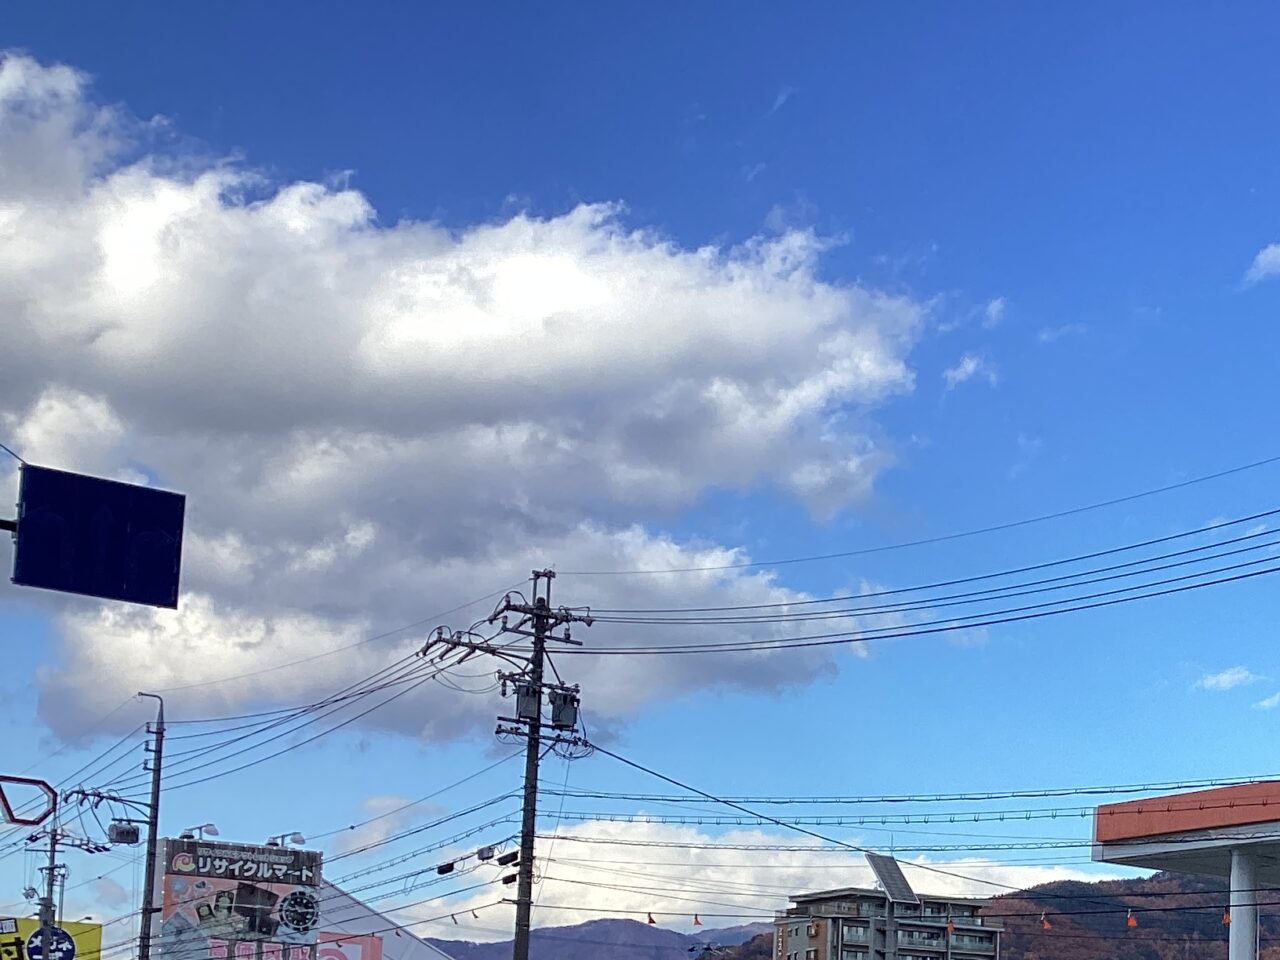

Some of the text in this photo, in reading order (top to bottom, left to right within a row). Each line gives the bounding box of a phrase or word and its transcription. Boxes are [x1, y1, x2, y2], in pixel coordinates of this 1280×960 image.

[198, 857, 313, 881] リサイクルマート
